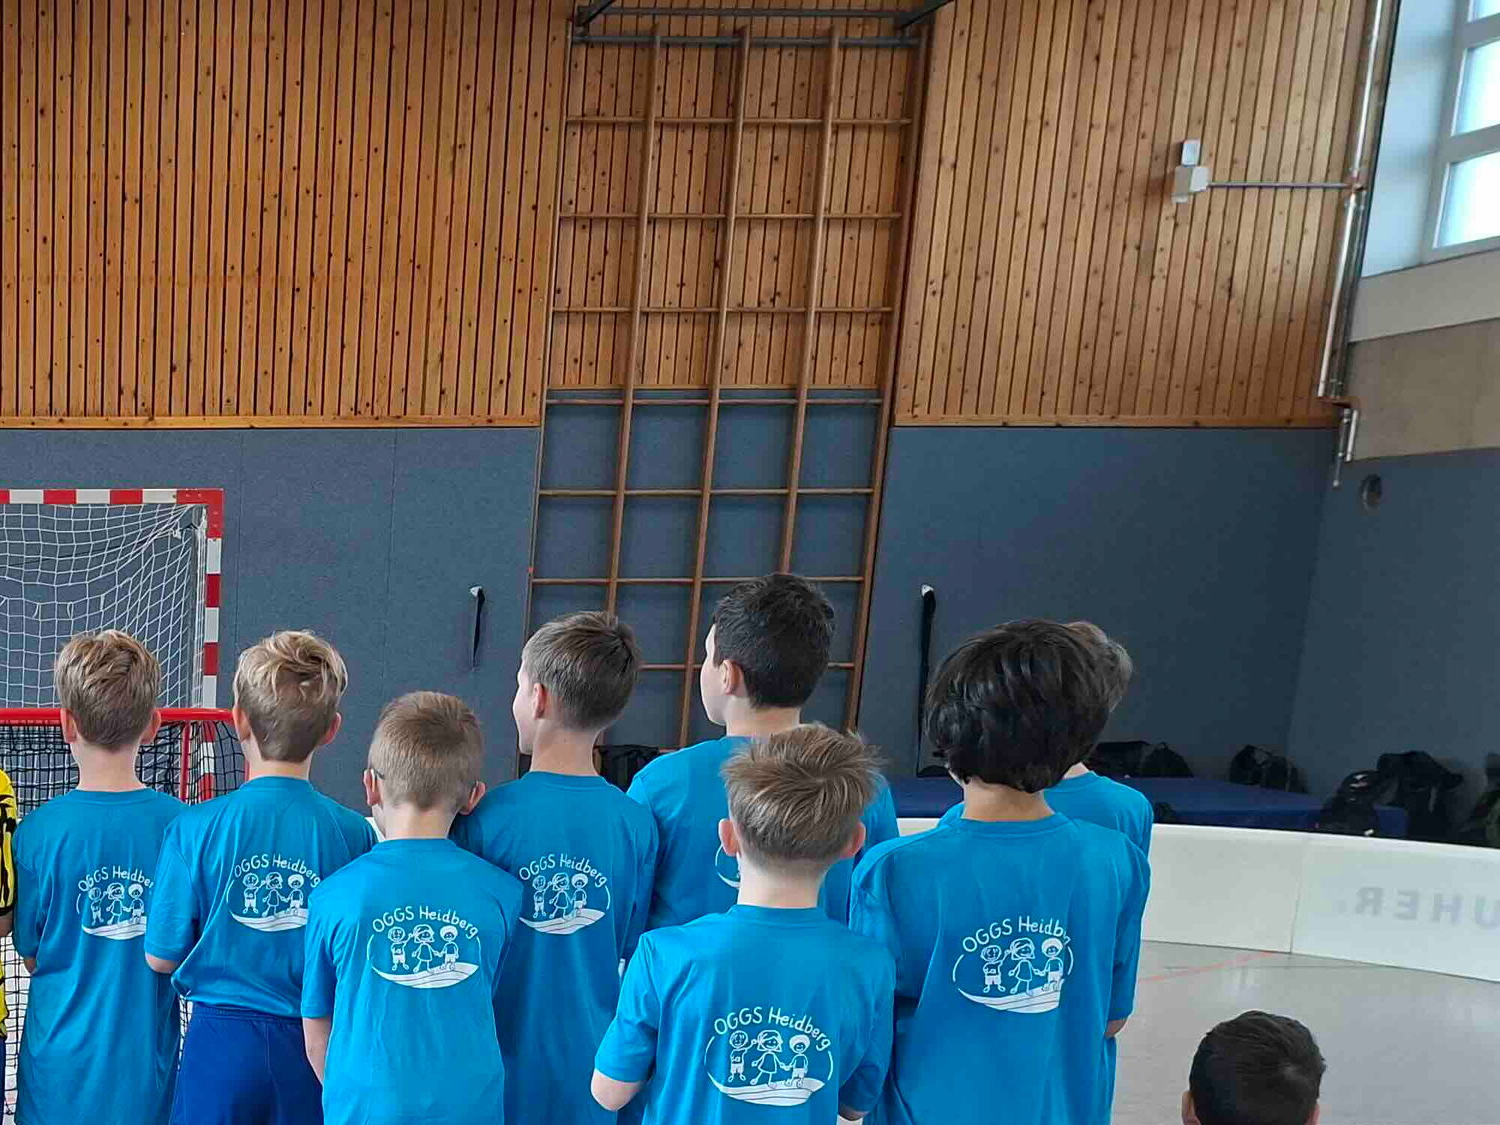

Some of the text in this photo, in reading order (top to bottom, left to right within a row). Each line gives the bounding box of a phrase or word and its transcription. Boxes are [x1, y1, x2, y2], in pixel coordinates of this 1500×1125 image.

[78, 866, 109, 892] OGGS
[236, 853, 321, 888] OGGS Heidberg
[519, 853, 607, 888] OGGS Heidberg
[372, 905, 479, 940] OGGS Heidberg
[962, 918, 1013, 953] OGGS
[714, 1001, 831, 1052] OGGS Heidberg
